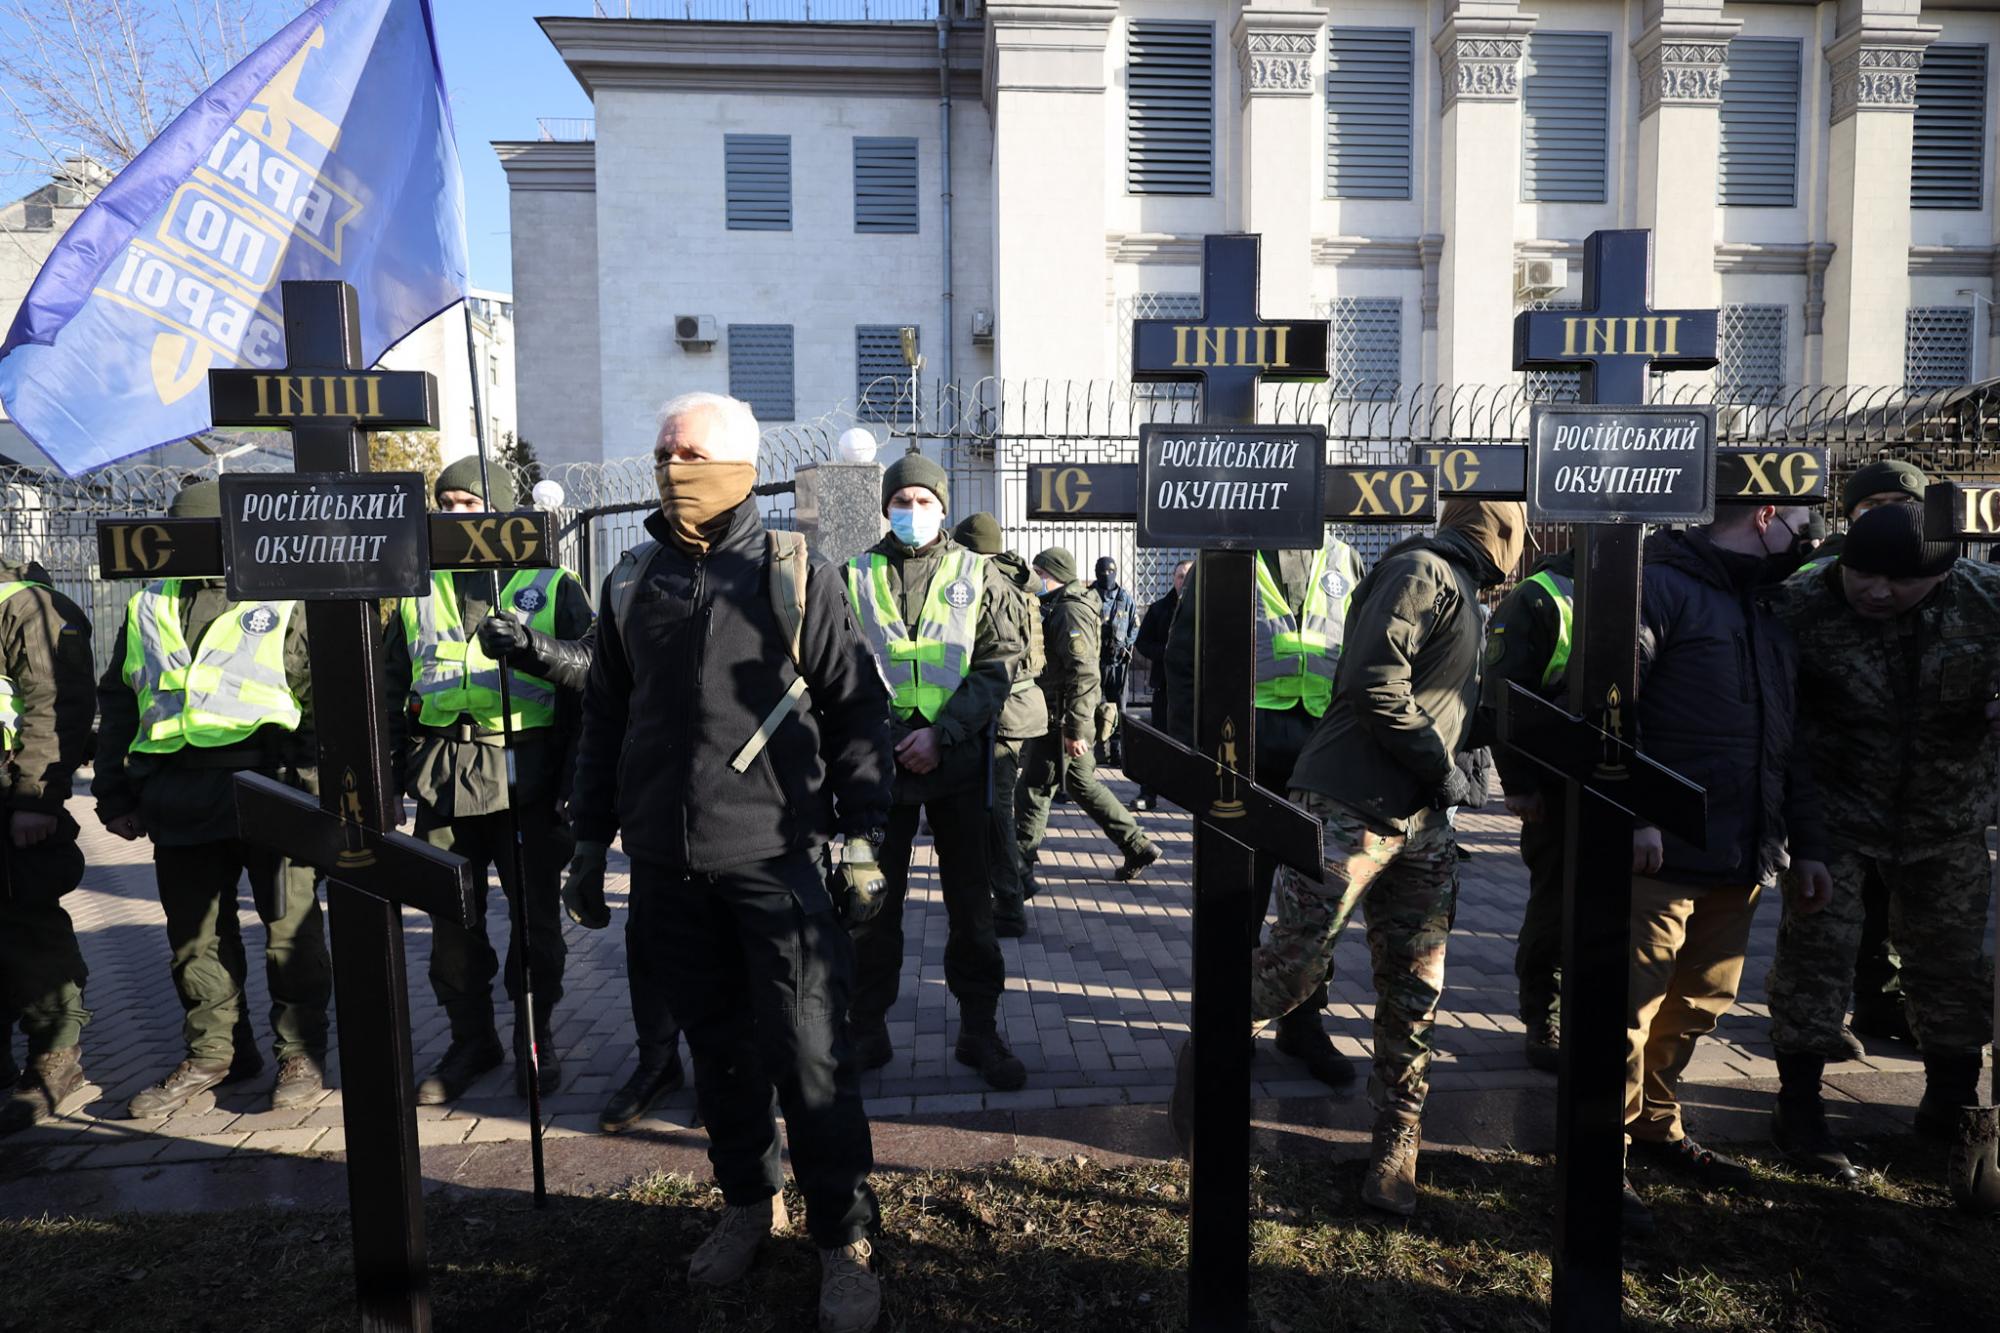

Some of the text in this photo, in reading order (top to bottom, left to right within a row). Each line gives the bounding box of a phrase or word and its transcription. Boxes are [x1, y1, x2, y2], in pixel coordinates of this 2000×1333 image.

[1159, 434, 1300, 469] РОСІЙСЬКИЙ
[1553, 419, 1700, 451] РОСІЙСЬКИЙ
[1554, 465, 1682, 494] ОКУПАНТ
[1737, 452, 1819, 495] ХС
[242, 484, 408, 522] РОСІЙСЬКИЙ
[1158, 480, 1288, 510] ОКУПАНТ
[1348, 471, 1428, 516] ХС
[255, 534, 387, 565] ОКУПАНТ
[457, 517, 539, 564] ХС
